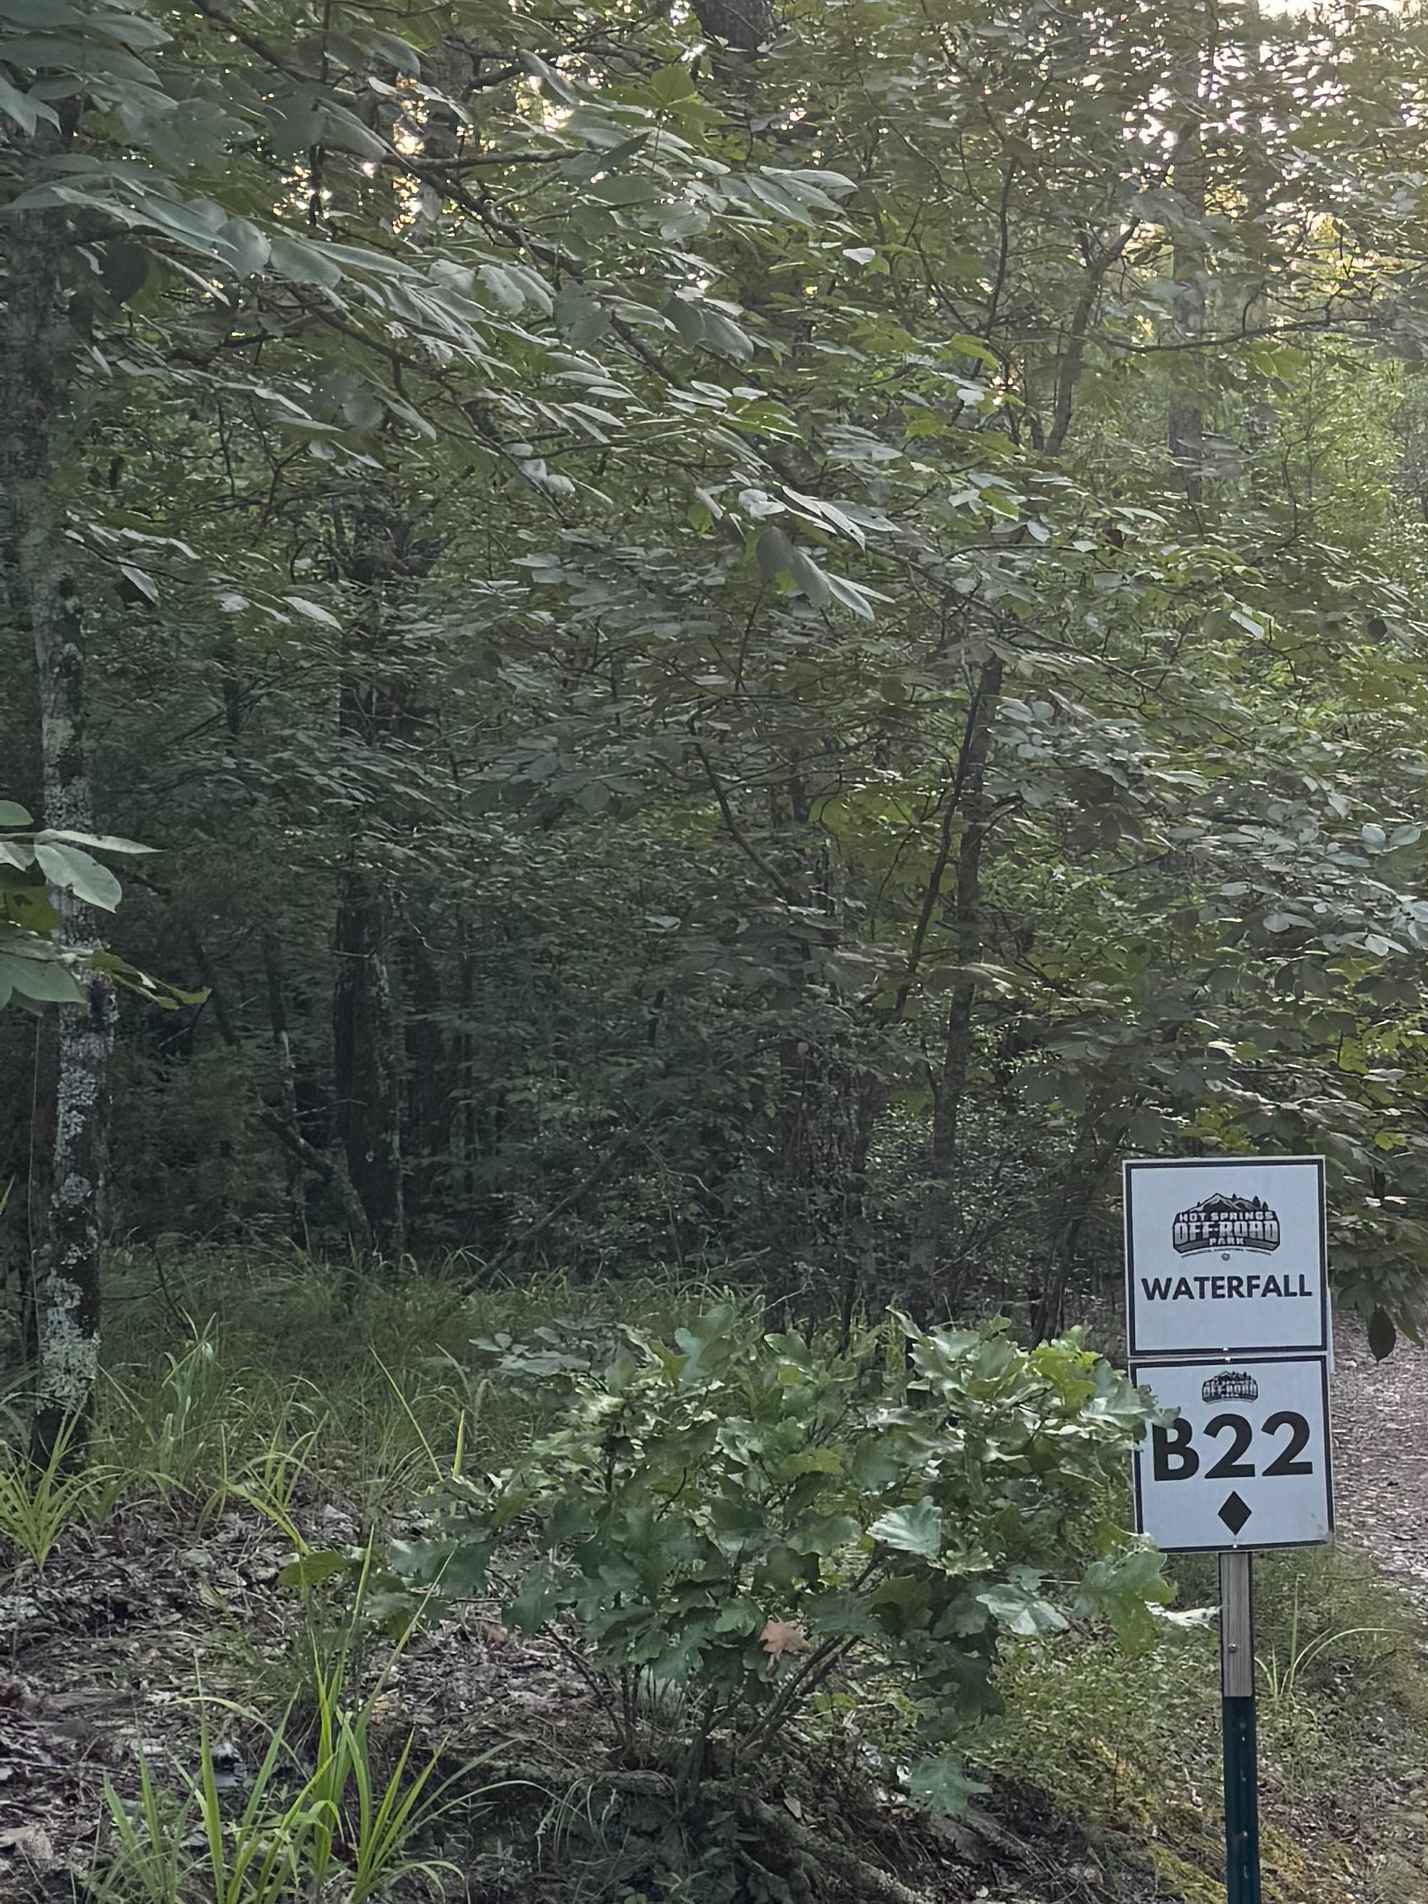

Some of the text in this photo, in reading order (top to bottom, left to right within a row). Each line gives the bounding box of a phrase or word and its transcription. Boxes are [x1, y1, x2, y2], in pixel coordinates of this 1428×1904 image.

[1179, 1211, 1274, 1222] HOT SPRINGS
[1174, 1220, 1279, 1245] OFF-ROAD
[1209, 1237, 1245, 1245] PARK
[1141, 1274, 1312, 1300] WATERFALL
[1152, 1411, 1313, 1481] B22
